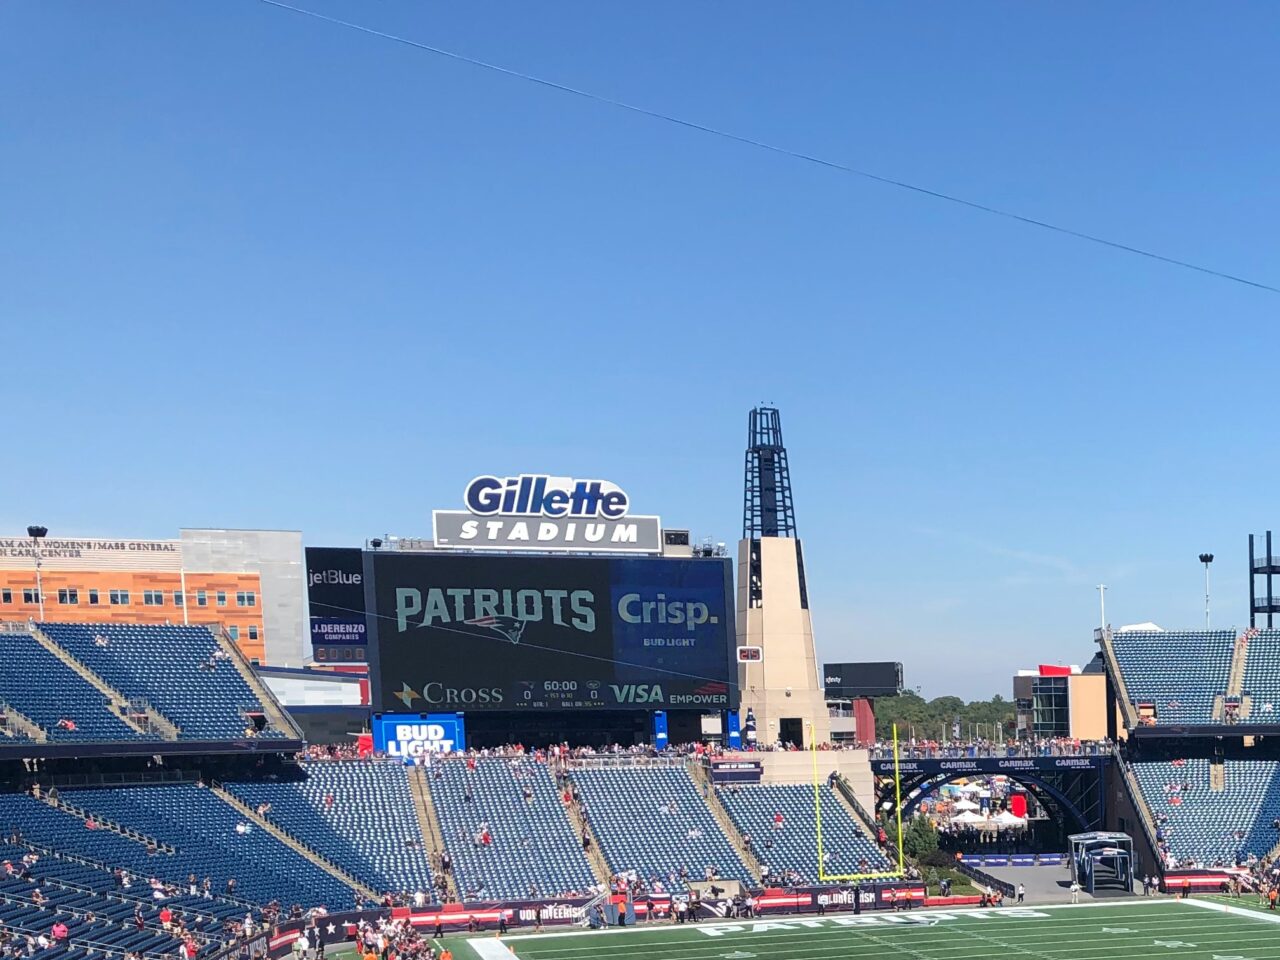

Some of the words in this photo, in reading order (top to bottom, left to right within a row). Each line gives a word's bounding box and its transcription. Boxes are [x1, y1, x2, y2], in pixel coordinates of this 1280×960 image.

[465, 475, 629, 517] Gillette
[459, 520, 638, 543] STADIUM
[41, 548, 81, 557] CENTER
[129, 543, 176, 551] GENERAL
[308, 569, 362, 586] jetBlue
[395, 587, 597, 633] PATRIOTS
[617, 593, 719, 631] Crisp.
[312, 623, 365, 633] J.DERENZO
[643, 638, 665, 647] BUD
[666, 638, 696, 647] LIGHT
[423, 682, 503, 704] CROSS
[544, 680, 577, 691] 60:00
[609, 684, 664, 703] VISA
[523, 690, 532, 700] 0
[590, 690, 598, 700] 0
[669, 694, 727, 704] EMPOWER
[396, 724, 445, 741] BUD
[387, 740, 454, 757] LIGHT
